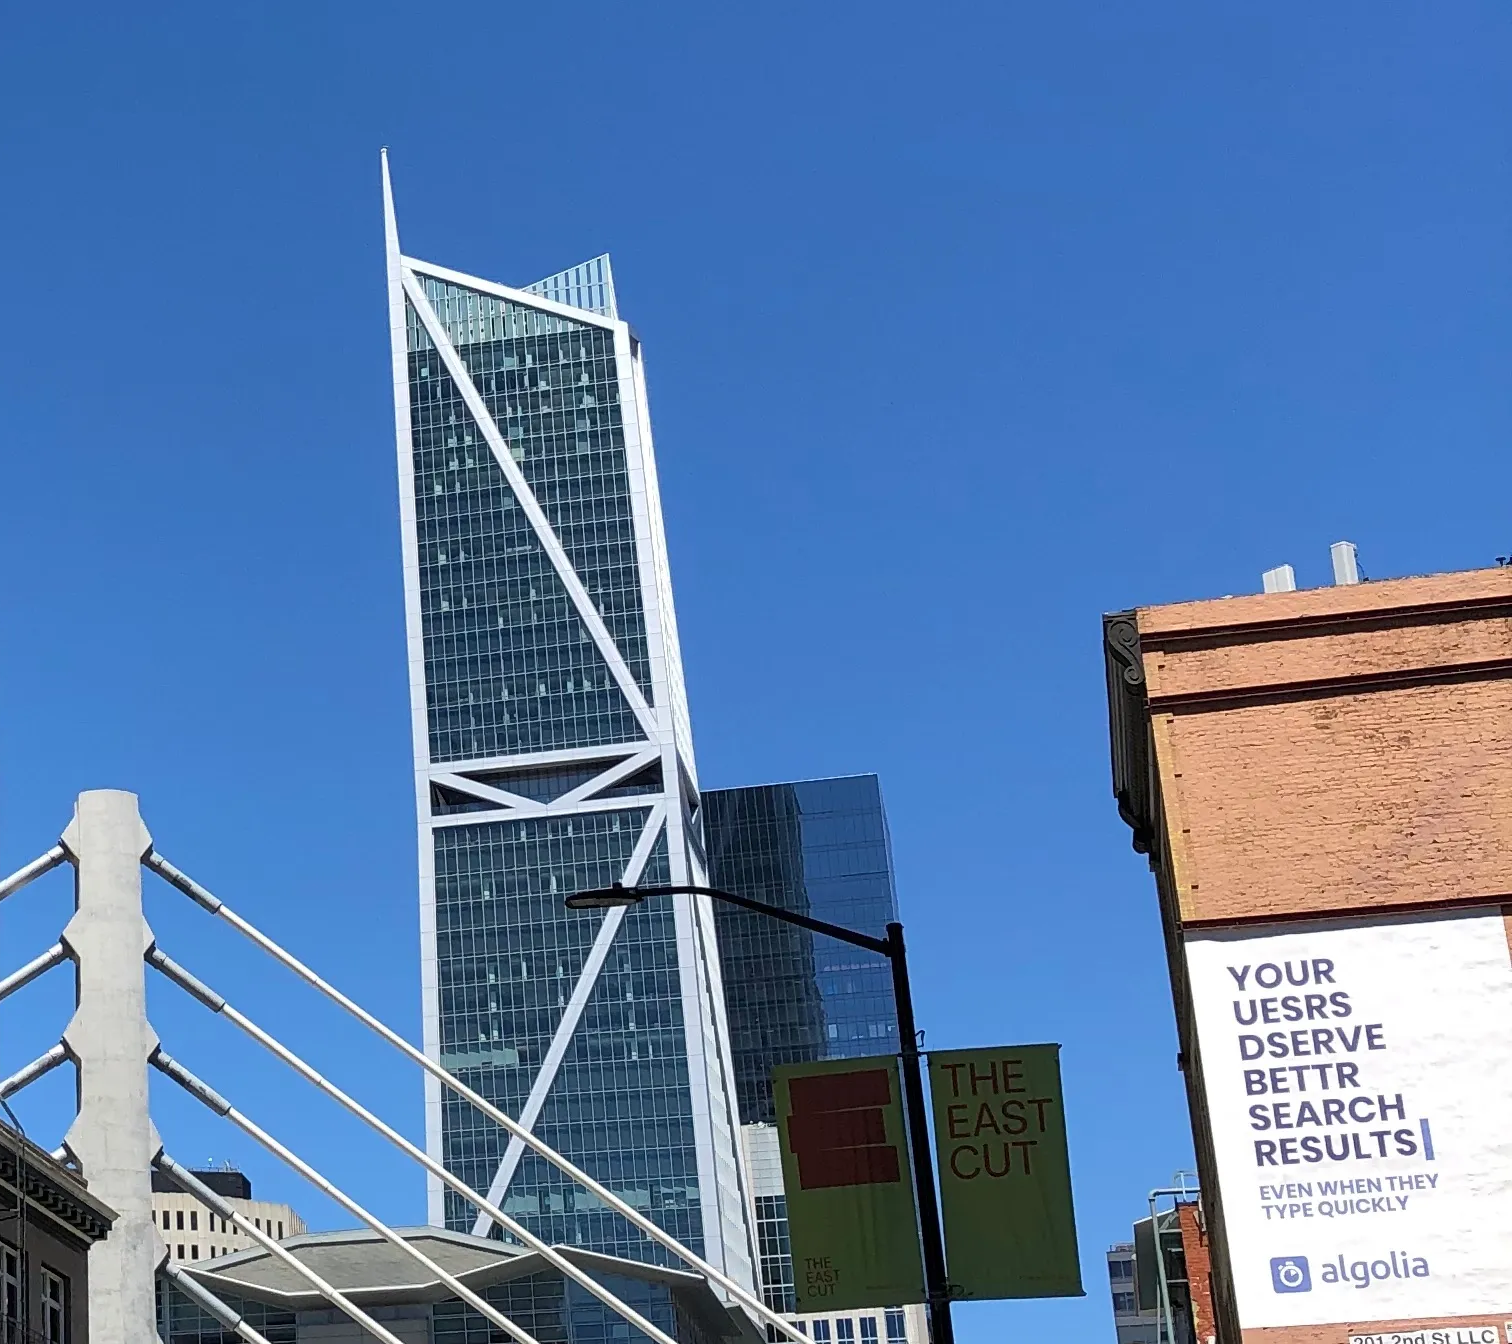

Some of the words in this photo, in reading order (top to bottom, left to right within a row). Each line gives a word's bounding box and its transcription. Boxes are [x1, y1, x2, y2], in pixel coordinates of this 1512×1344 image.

[1226, 958, 1337, 991] YOUR
[1233, 991, 1353, 1026] UESRS
[1238, 1023, 1387, 1061] DSERVE
[941, 1060, 1026, 1097] THE
[1243, 1061, 1361, 1097] BETTR
[947, 1098, 1053, 1139] EAST
[1248, 1093, 1406, 1131] SEARCH
[950, 1141, 1038, 1180] CUT
[1254, 1128, 1418, 1167] RESULTS
[1259, 1181, 1314, 1200] EVEN
[1317, 1177, 1383, 1196] WHEN
[1385, 1173, 1439, 1192] THEY
[1261, 1202, 1314, 1220] TYPE
[1317, 1195, 1409, 1218] QUICKLY
[804, 1256, 832, 1269] THE
[806, 1269, 840, 1284] EAST
[1321, 1250, 1430, 1289] algolia
[808, 1283, 836, 1297] CUT
[1456, 1329, 1495, 1344] LLC
